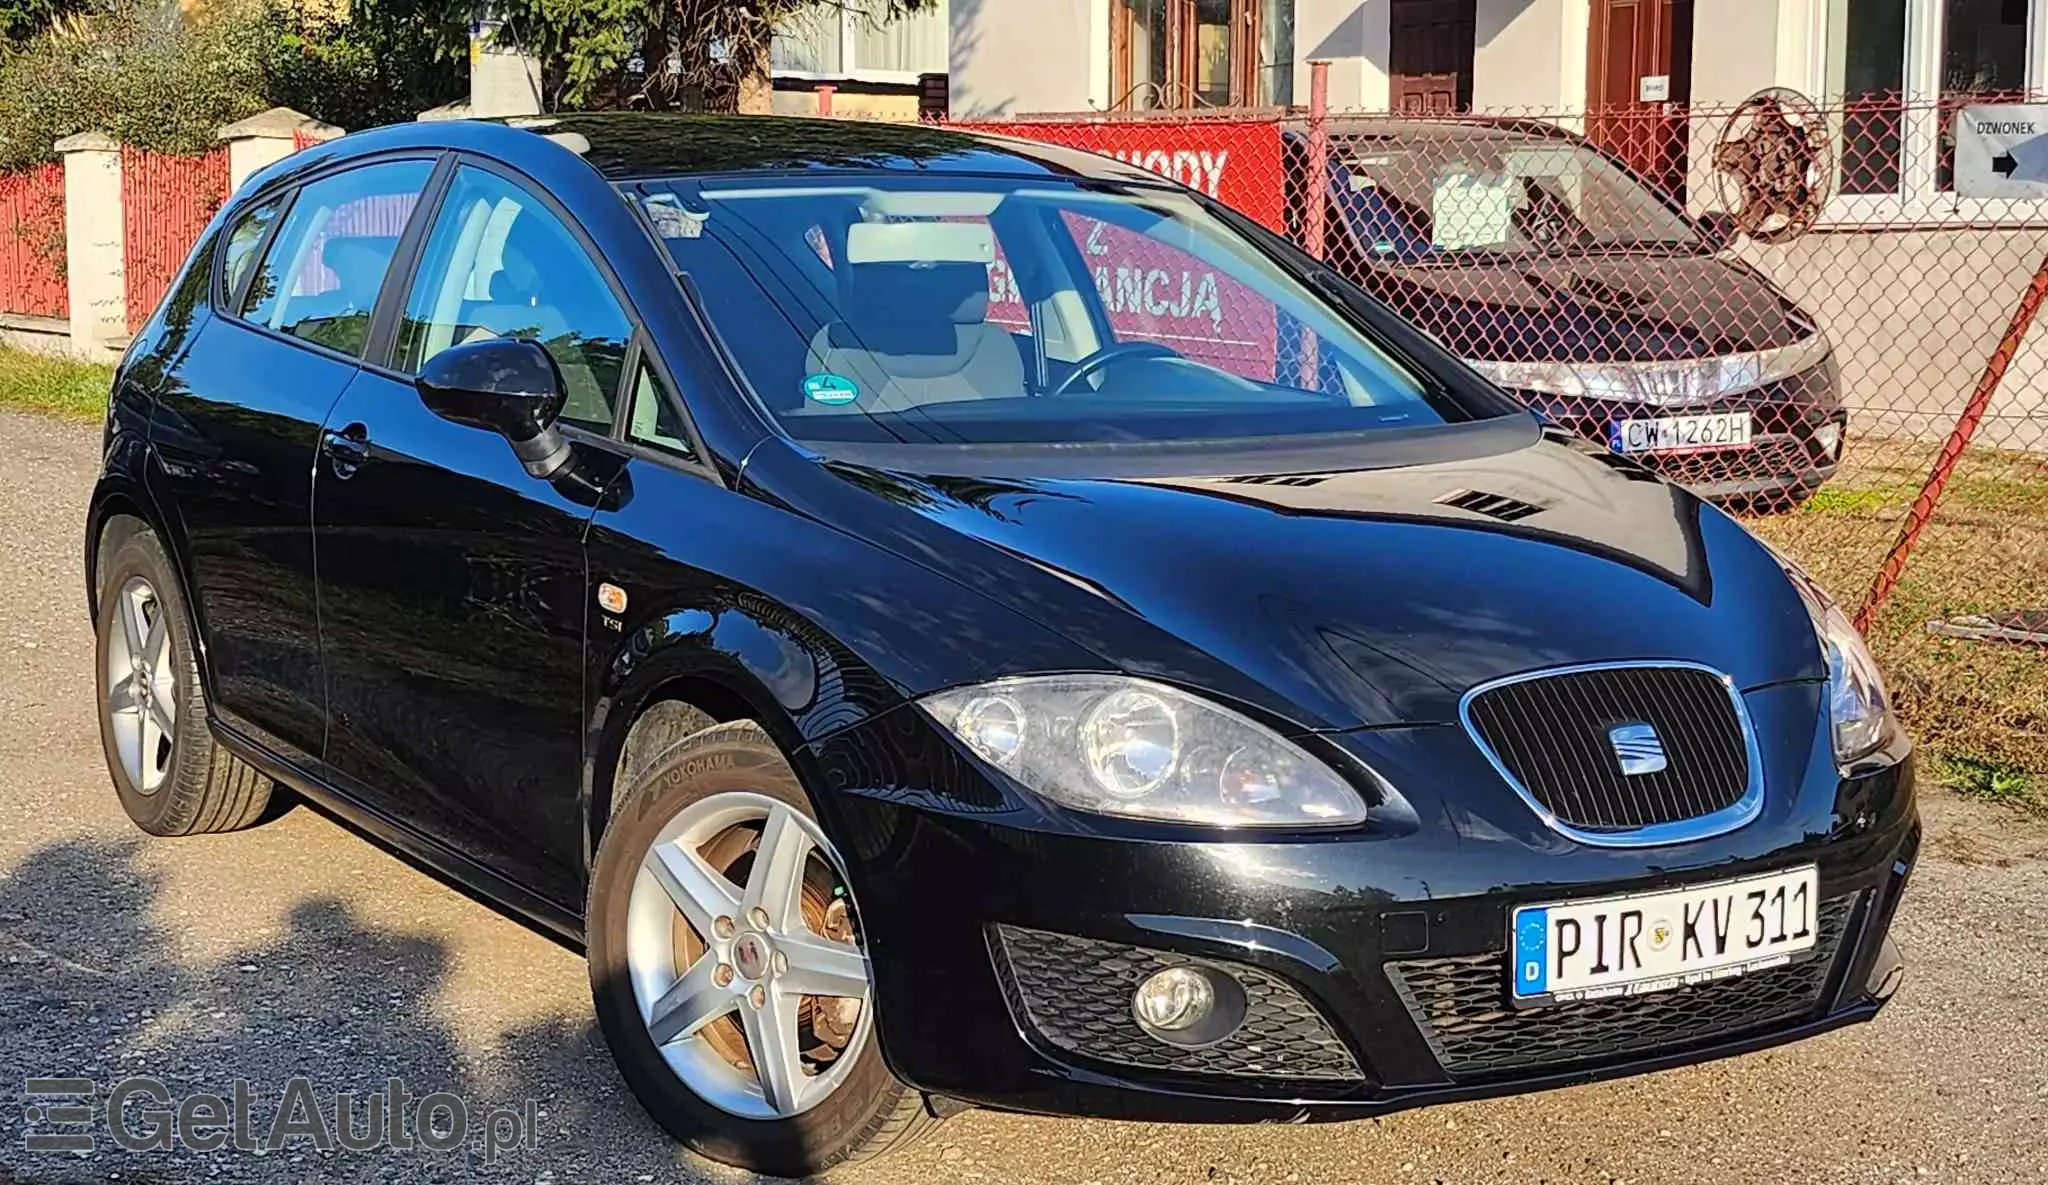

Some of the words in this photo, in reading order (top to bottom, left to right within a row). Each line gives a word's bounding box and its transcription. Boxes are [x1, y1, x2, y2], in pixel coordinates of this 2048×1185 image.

[1977, 121, 2035, 134] DZWONEK
[1628, 421, 1659, 447] CW
[1672, 417, 1744, 445] 1262H
[601, 614, 622, 632] TSI
[663, 754, 735, 786] YOKOHAMA
[1555, 909, 1643, 979] PIR
[1681, 895, 1733, 962] KV
[1745, 880, 1810, 948] 311
[1525, 961, 1539, 981] D
